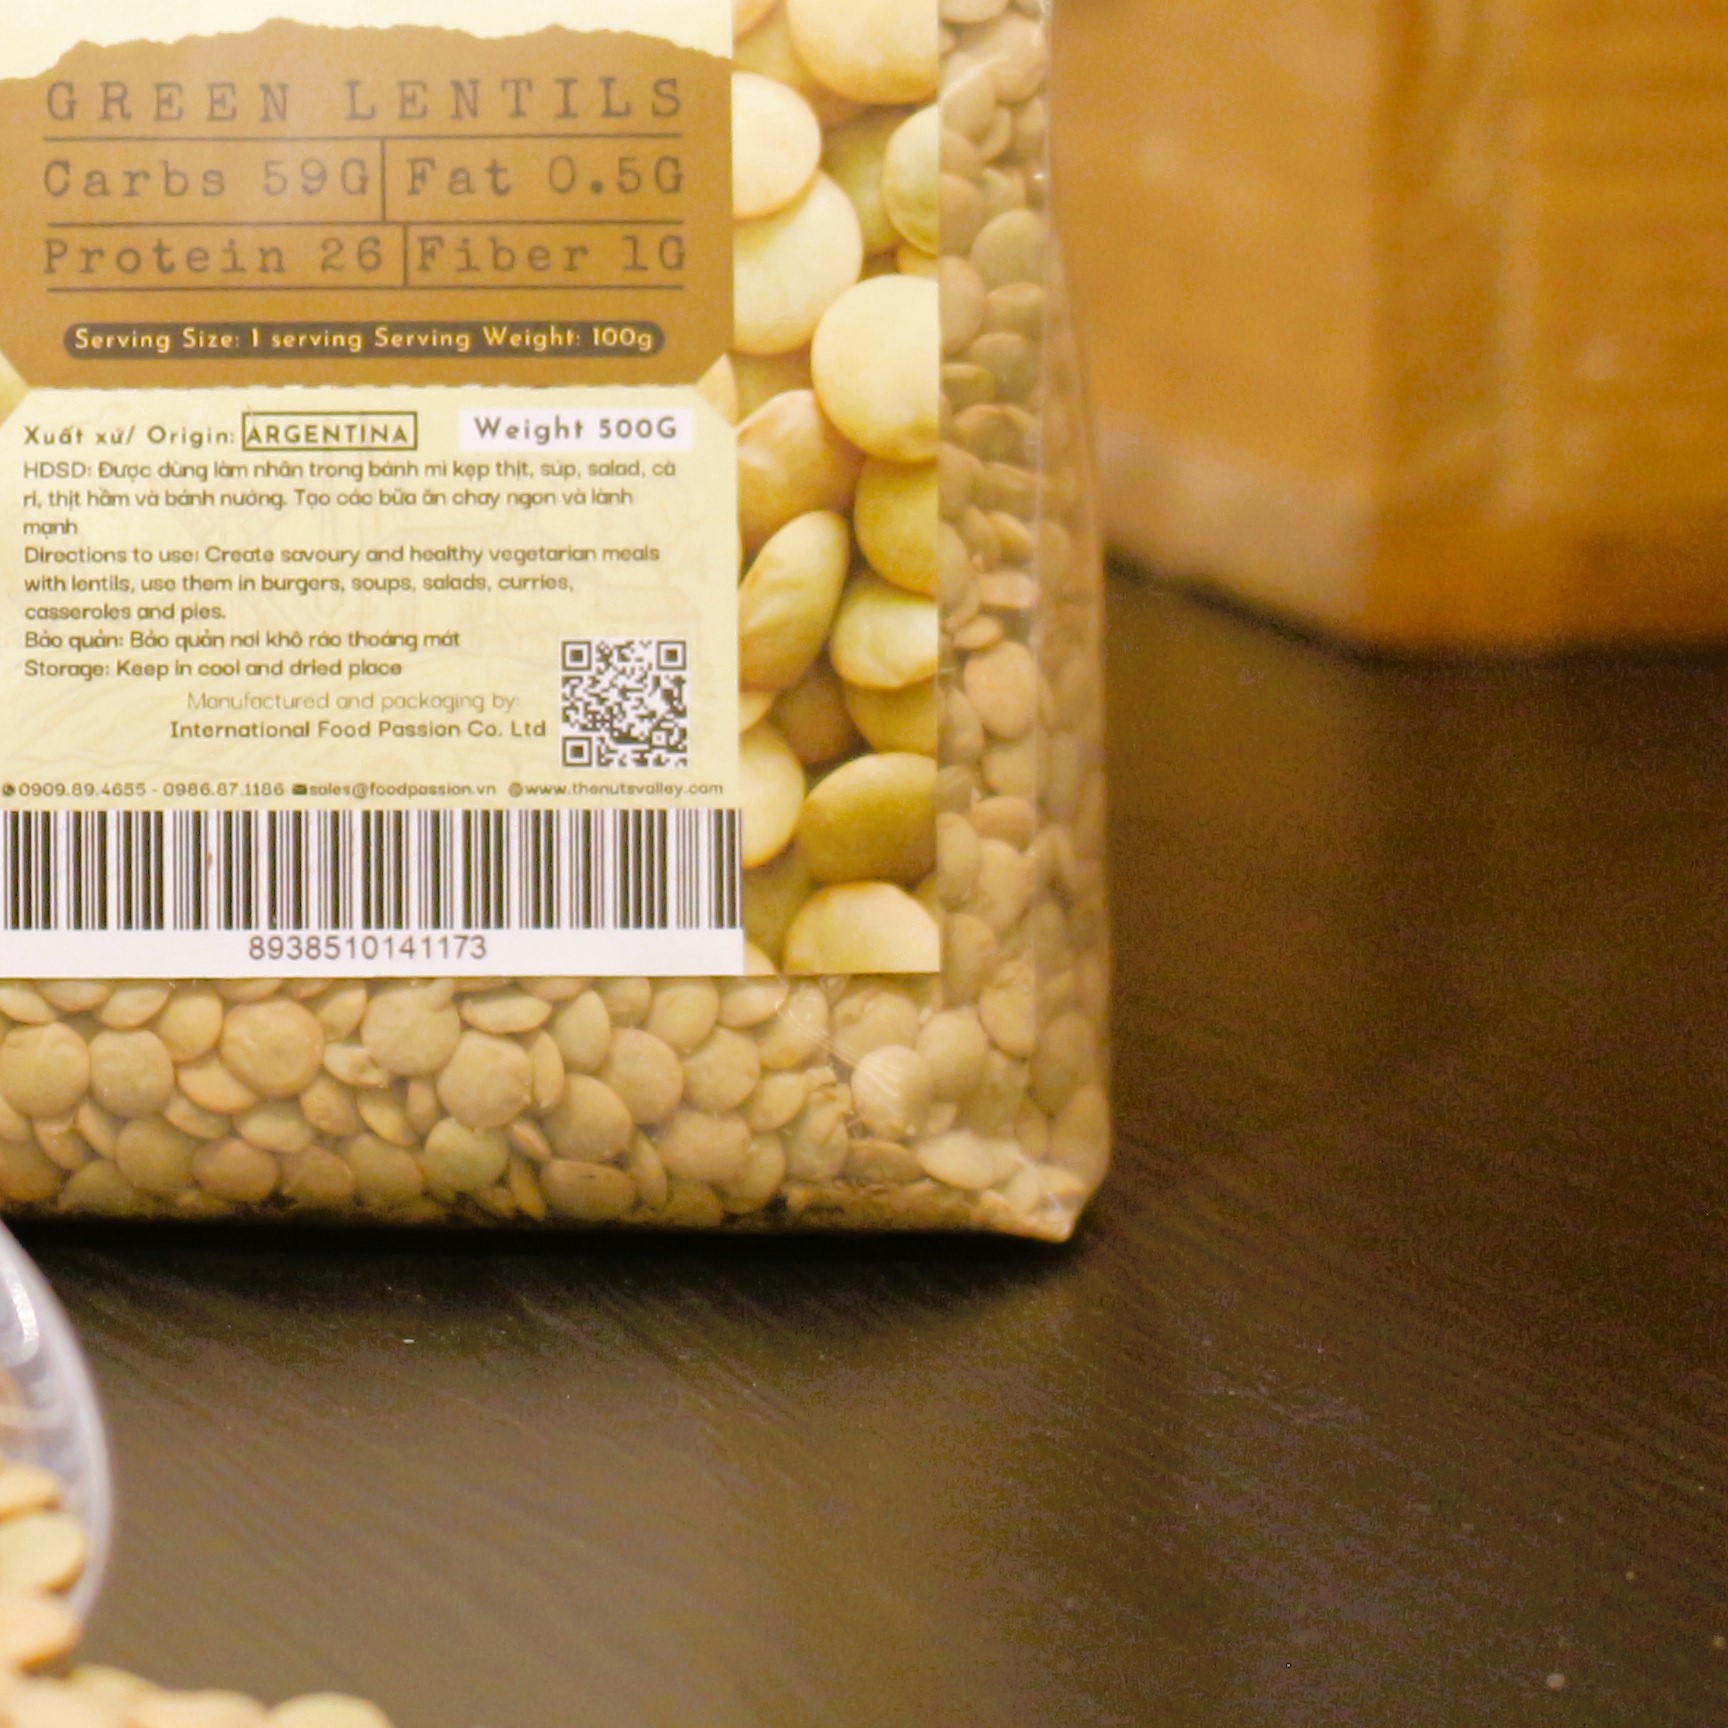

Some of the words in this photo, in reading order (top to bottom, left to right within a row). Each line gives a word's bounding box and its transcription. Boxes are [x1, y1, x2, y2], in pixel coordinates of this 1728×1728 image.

[45, 80, 288, 123] GREEN
[345, 77, 684, 120] LENTILS
[43, 158, 225, 199] Carbs
[261, 158, 371, 196] 59G
[407, 157, 512, 198] Fat
[549, 155, 685, 196] 0.5G
[44, 238, 287, 275] Protein
[320, 236, 383, 274] 26
[417, 235, 590, 274] Fiber
[622, 234, 685, 272] 1G
[74, 328, 170, 353] Serving
[182, 328, 241, 349] Size:
[272, 330, 362, 352] serving
[375, 326, 470, 352] Serving
[482, 328, 581, 352] Weight:
[593, 327, 652, 351] 100g
[25, 426, 83, 445] Xuất
[148, 425, 234, 449] Origin:
[246, 424, 407, 445] ARGENTINA
[474, 415, 583, 445] Weight
[600, 416, 676, 439] 500G
[24, 461, 91, 478] HDSD:
[158, 461, 208, 482] dùng
[254, 461, 303, 478] nhân
[309, 462, 363, 483] trong
[368, 460, 418, 477] bánh
[453, 460, 490, 481] kẹp
[588, 460, 645, 478] salad,
[48, 490, 80, 510] thịt
[135, 490, 160, 506] và
[165, 490, 215, 506] bánh
[294, 488, 331, 509] Tạo
[336, 490, 373, 506] các
[452, 489, 500, 510] chay
[507, 493, 556, 509] ngon
[562, 488, 586, 505] và
[592, 488, 633, 505] lành
[25, 546, 127, 564] Directions
[133, 548, 153, 563] to
[159, 550, 199, 563] use:
[205, 546, 274, 563] Create
[281, 549, 360, 567] savoury
[366, 546, 404, 562] and
[410, 545, 483, 566] healthy
[489, 546, 596, 566] vegetarian
[603, 545, 660, 561] meals
[25, 576, 66, 592] with
[72, 575, 135, 593] lentils,
[141, 578, 176, 592] use
[182, 575, 232, 591] them
[238, 575, 256, 591] in
[261, 575, 345, 596] burgers,
[352, 577, 416, 595] soups,
[423, 574, 491, 591] salads,
[498, 574, 573, 591] curries,
[25, 603, 131, 621] casseroles
[137, 603, 175, 620] and
[181, 603, 226, 624] pies.
[266, 631, 303, 647] khô
[348, 630, 418, 652] thoáng
[424, 631, 460, 647] mát
[25, 659, 109, 682] Storage:
[117, 660, 169, 680] Keep
[175, 660, 192, 675] in
[198, 659, 240, 676] cool
[246, 660, 283, 676] and
[290, 659, 342, 676] dried
[349, 659, 402, 680] place
[187, 692, 332, 710] Manufactured
[336, 693, 374, 710] and
[381, 692, 485, 714] packaging
[492, 693, 519, 714] by:
[171, 721, 310, 738] International
[318, 720, 371, 738] Food
[379, 720, 461, 737] Passion
[467, 720, 502, 737] Co.
[511, 720, 546, 737] Ltd
[307, 782, 496, 800] sales@foodpassion.vn
[523, 782, 723, 798] www.thenutsvalley.com
[249, 935, 487, 960] 8938510141173
